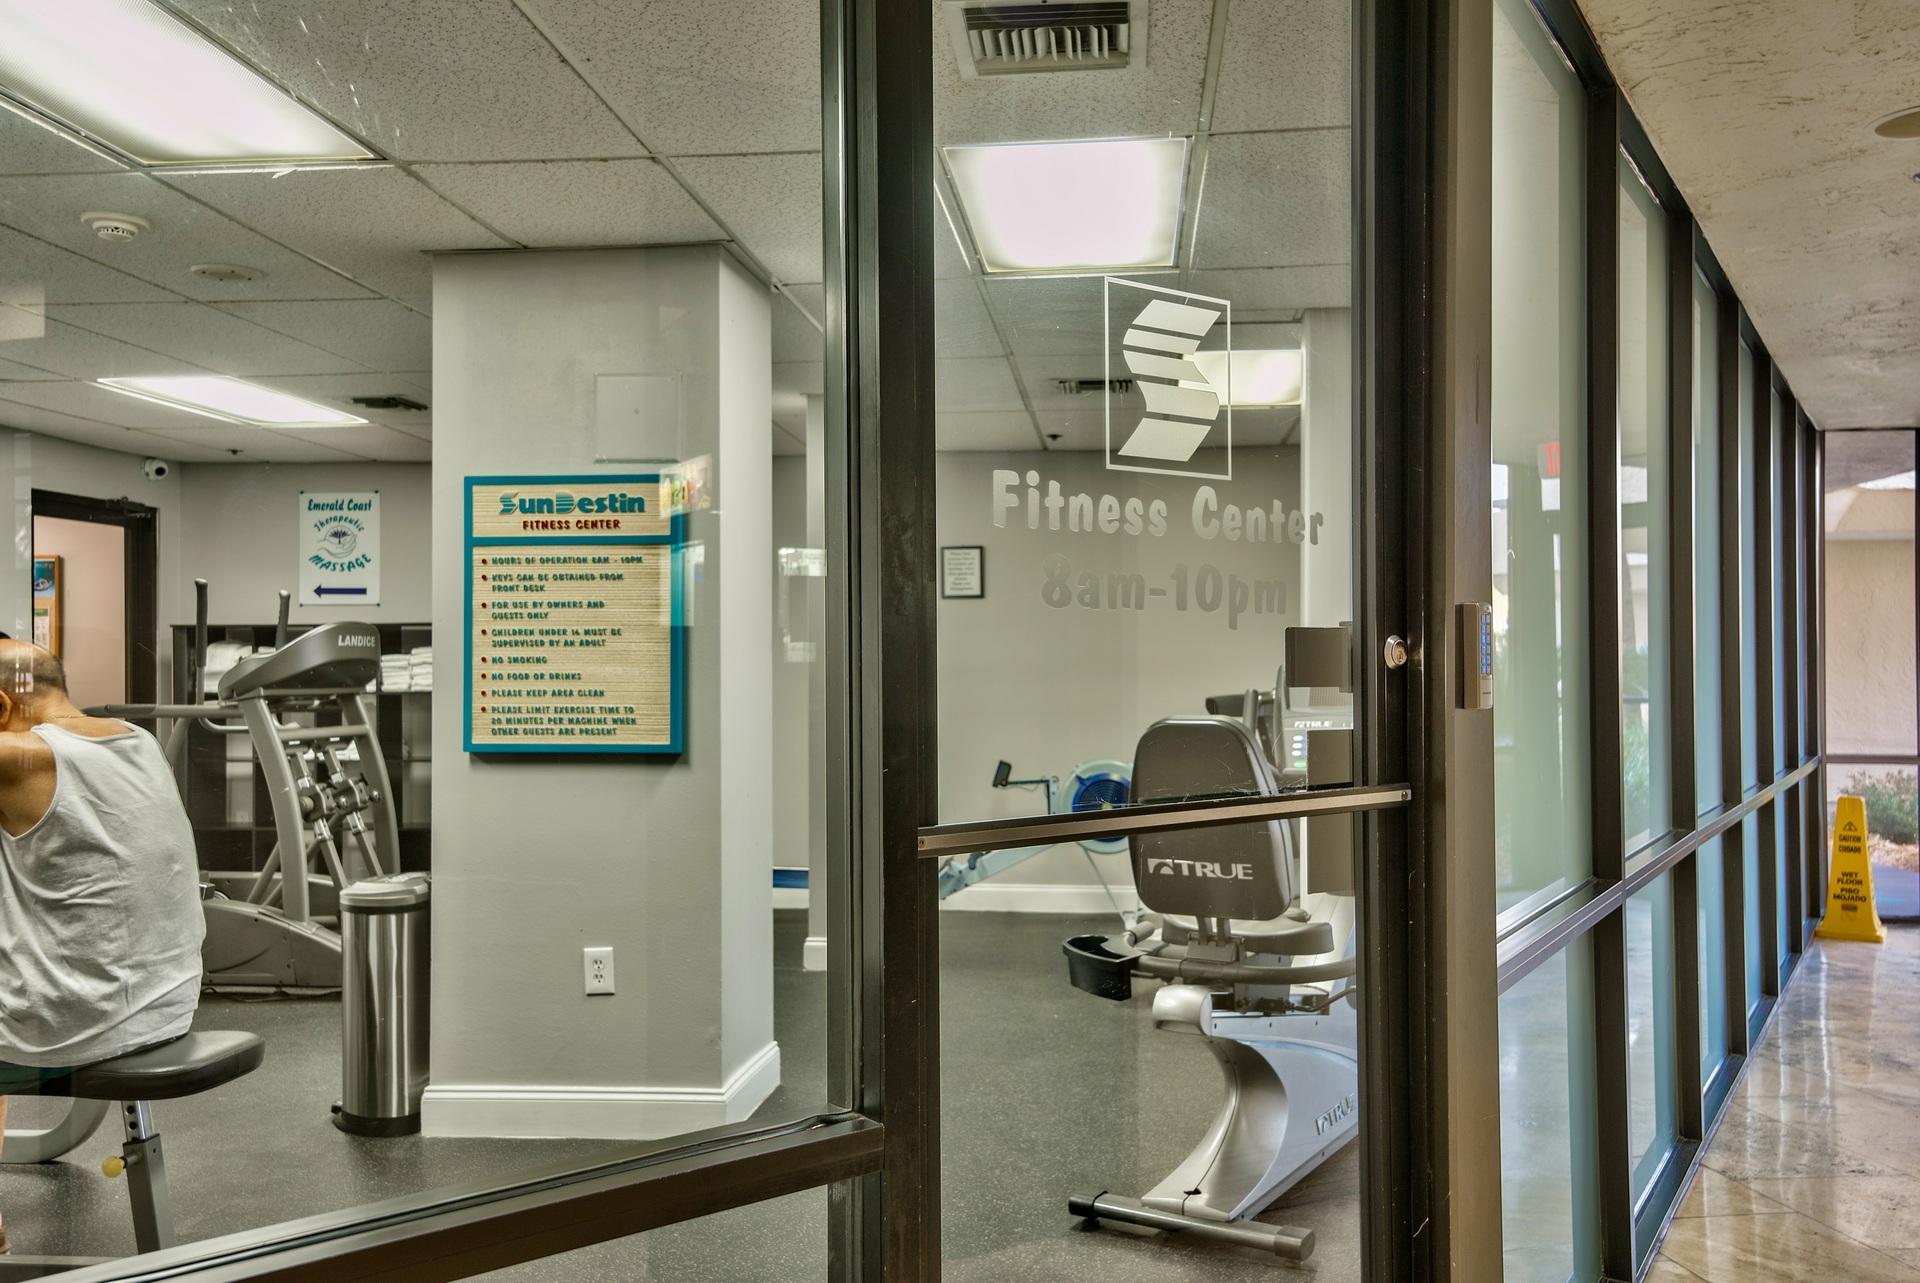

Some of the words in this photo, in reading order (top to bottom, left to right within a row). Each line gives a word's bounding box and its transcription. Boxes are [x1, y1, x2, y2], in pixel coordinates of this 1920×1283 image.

[307, 499, 345, 512] Emerald
[347, 498, 372, 512] Coast
[499, 490, 646, 515] SunDestin
[993, 469, 1167, 537] Fitness
[1192, 485, 1324, 546] Center
[313, 514, 365, 532] Therapeutic
[522, 519, 571, 531] FITNESS
[575, 519, 622, 530] CENTER
[308, 553, 372, 573] MASSAGE
[491, 556, 522, 565] HOURS
[525, 556, 536, 565] OF
[539, 556, 588, 565] OPERATION
[620, 556, 643, 565] 10PM
[491, 573, 514, 582] KEYS
[516, 573, 535, 582] CAN
[537, 573, 549, 582] BE
[552, 573, 596, 582] OBTAINED
[599, 573, 624, 582] FROM
[491, 584, 520, 592] FRONT
[523, 584, 546, 592] DESK
[1041, 553, 1286, 630] 8am-10pm
[491, 601, 509, 609] FOR
[512, 601, 529, 609] USE
[532, 601, 543, 609] BY
[547, 601, 584, 609] OWNERS
[587, 601, 605, 609] AND
[491, 611, 524, 620] GUESTS
[527, 611, 549, 620] ONLY
[491, 628, 535, 637] CHILDREN
[538, 628, 568, 637] UNDER
[583, 628, 607, 637] MUST
[611, 628, 622, 637] BE
[338, 634, 376, 648] LANDICE
[491, 639, 545, 648] SUPERVISED
[548, 639, 560, 648] BY
[563, 639, 576, 648] AN
[579, 639, 606, 648] ADULT
[491, 656, 504, 664] NO
[507, 656, 548, 664] SMOKING
[491, 673, 504, 681] NO
[507, 673, 530, 681] FOOD
[533, 673, 546, 681] OR
[549, 673, 583, 681] DRINKS
[491, 689, 523, 697] PLEASE
[526, 689, 549, 697] KEEP
[551, 689, 575, 697] AREA
[577, 689, 605, 697] CLEAN
[491, 705, 523, 714] PLEASE
[526, 705, 550, 714] LIMIT
[554, 705, 596, 714] EXERCISE
[599, 705, 620, 714] TIME
[624, 705, 635, 714] TO
[505, 716, 544, 725] MINUTES
[547, 716, 564, 725] PER
[568, 716, 608, 725] MACHINE
[611, 716, 637, 725] WHEN
[491, 727, 519, 736] OTHER
[522, 727, 555, 736] GUESTS
[558, 727, 576, 736] ARE
[579, 727, 617, 736] PRESENT
[1838, 834, 1862, 843] CAUTION
[1838, 845, 1862, 854] CUIDADO
[1172, 859, 1254, 881] TRUE
[1837, 878, 1863, 886] FLOOR
[1840, 887, 1860, 895] PISO
[1833, 893, 1867, 903] MOJADO
